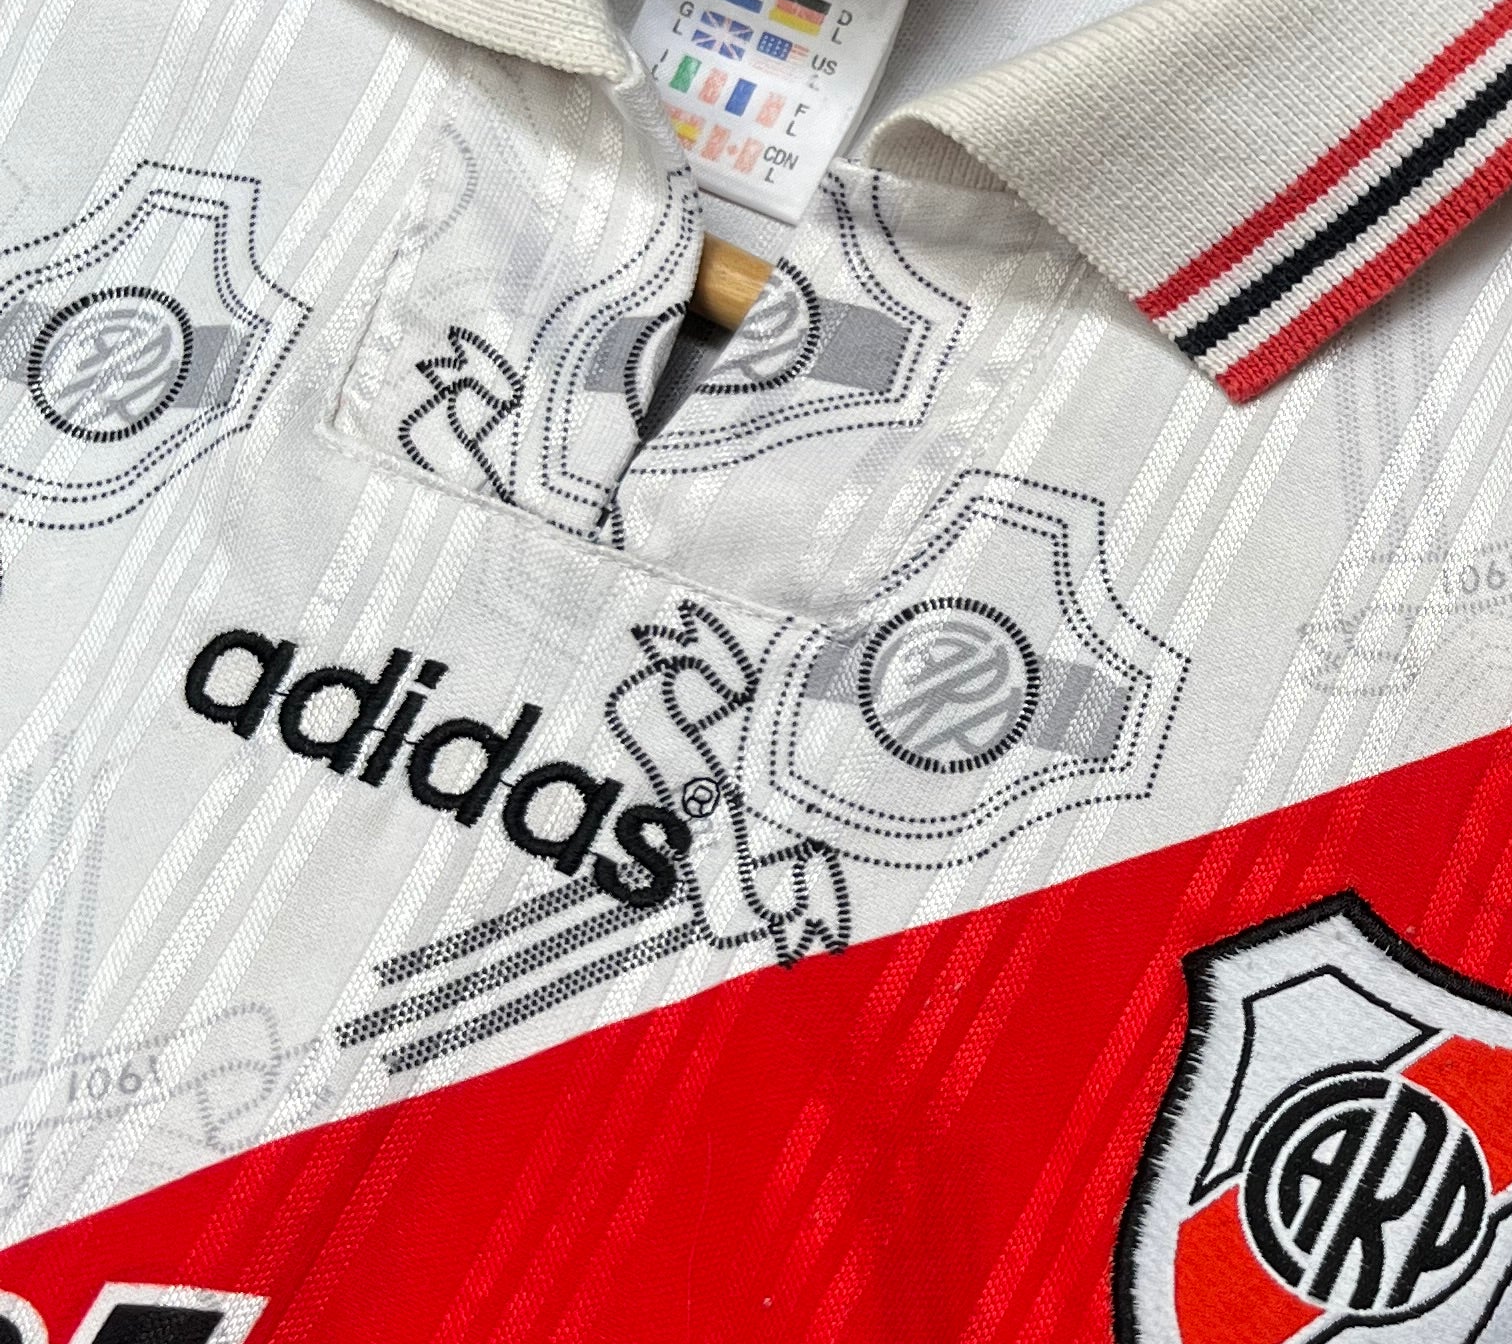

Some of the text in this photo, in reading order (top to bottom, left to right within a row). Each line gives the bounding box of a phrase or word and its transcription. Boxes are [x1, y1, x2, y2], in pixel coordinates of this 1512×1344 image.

[679, 1, 695, 18] G
[836, 9, 853, 27] D
[673, 18, 683, 36] L
[831, 27, 842, 45] L
[812, 54, 837, 75] US
[795, 102, 809, 117] F
[786, 119, 796, 137] L
[763, 145, 799, 171] CDN
[764, 167, 775, 184] L
